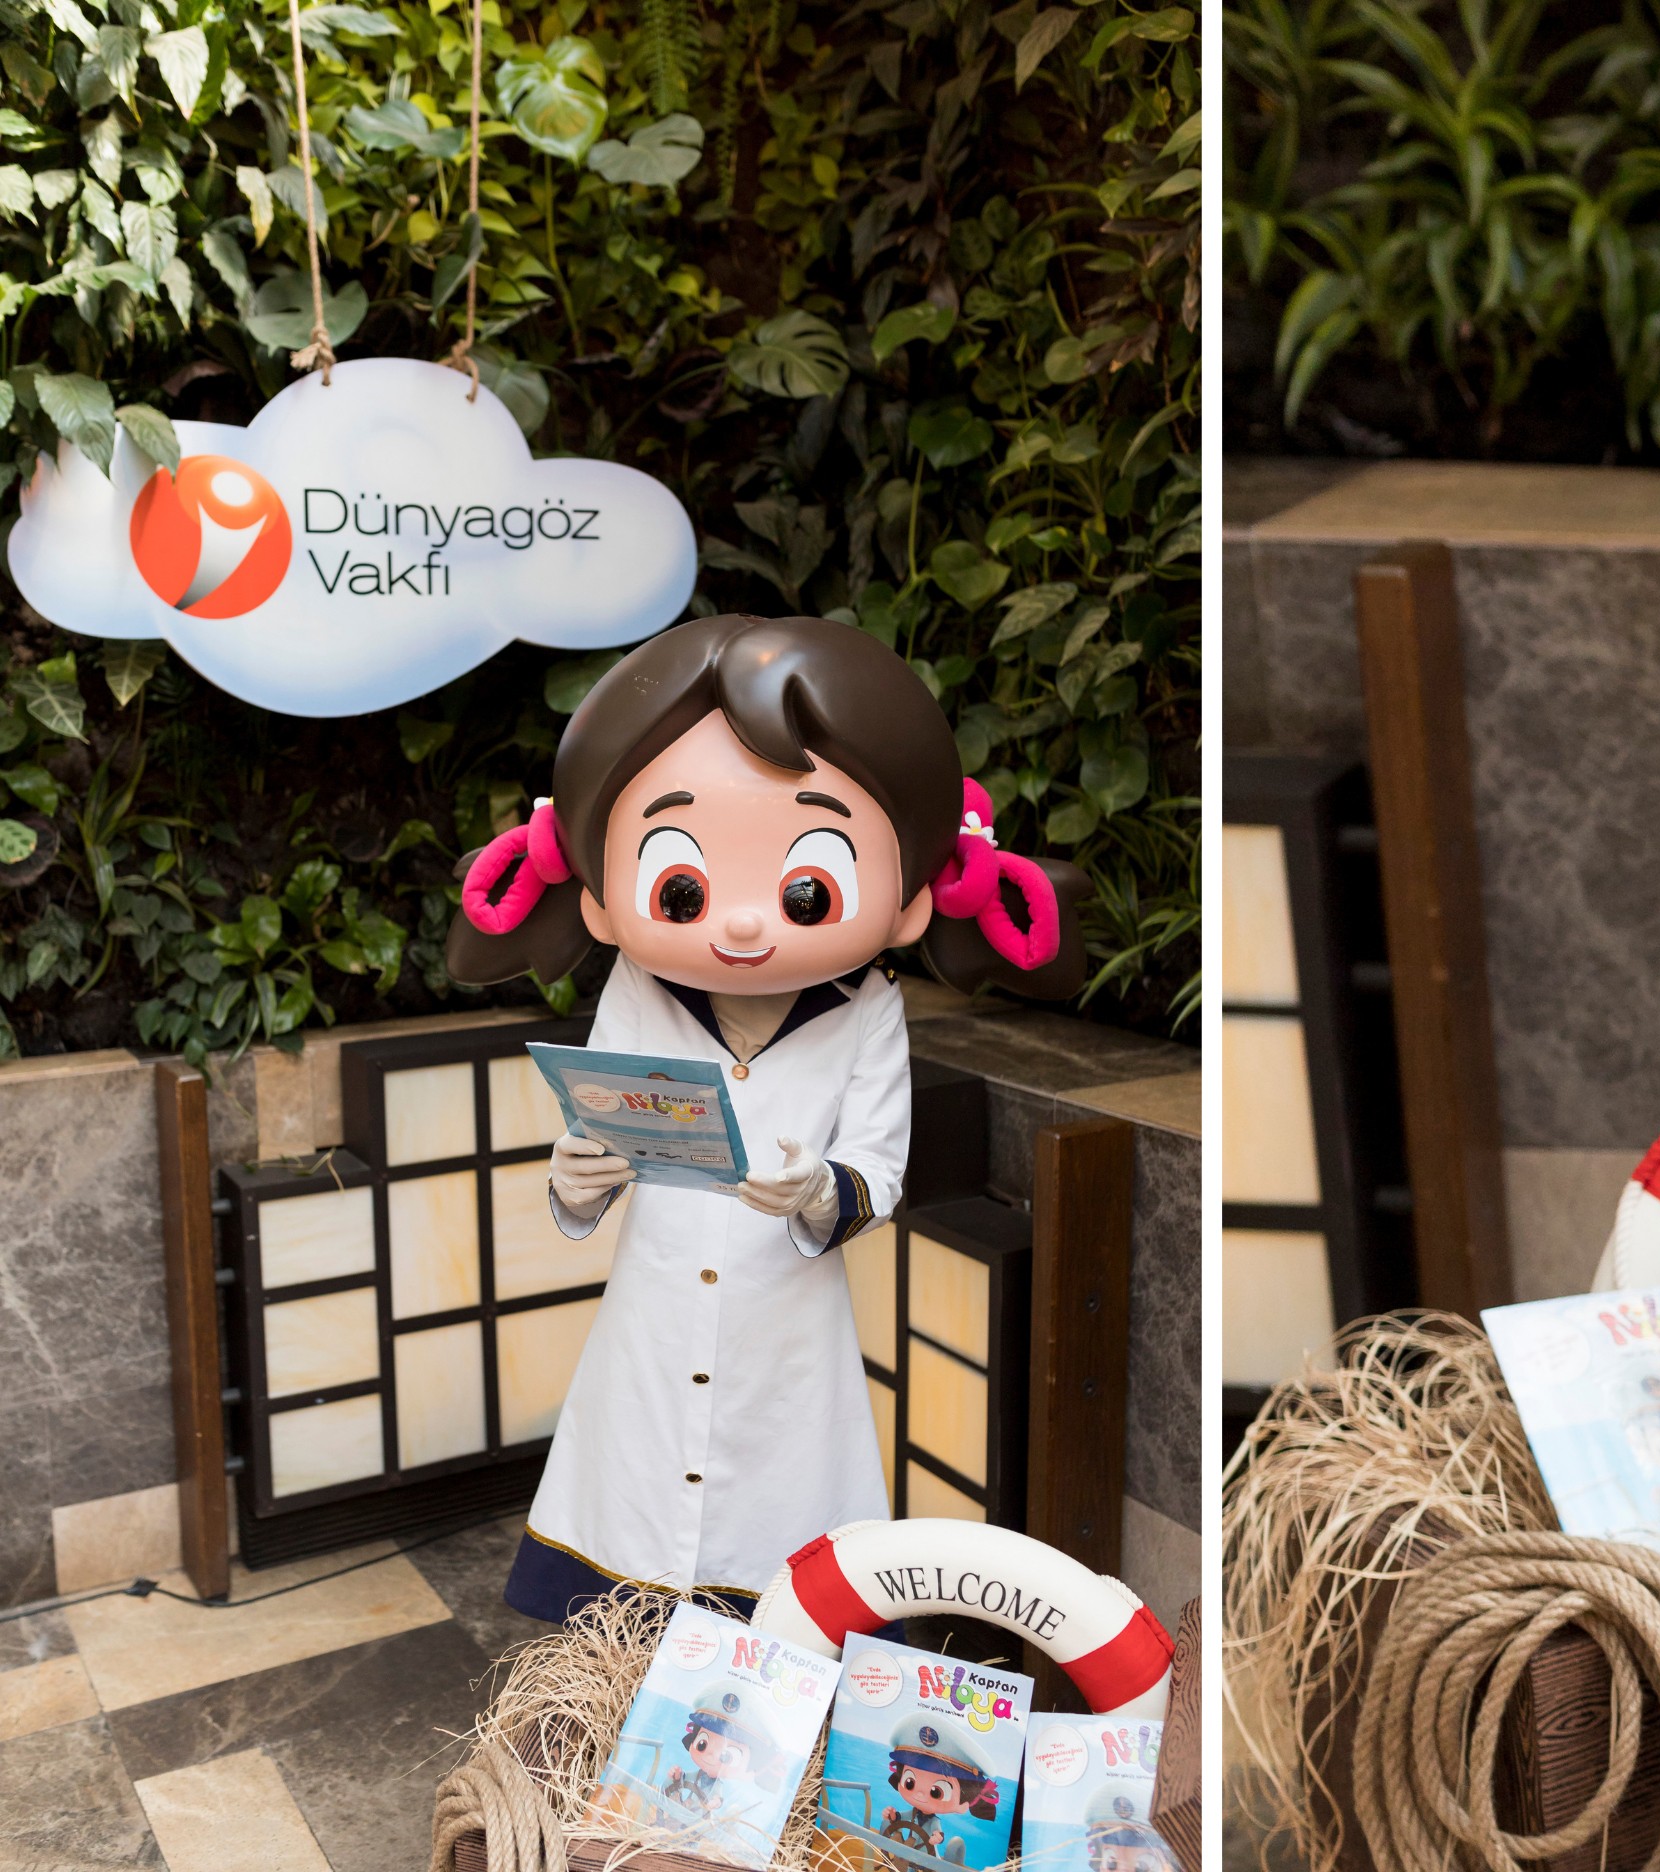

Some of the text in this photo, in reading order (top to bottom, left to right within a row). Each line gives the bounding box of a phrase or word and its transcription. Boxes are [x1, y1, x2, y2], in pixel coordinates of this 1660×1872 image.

[303, 487, 600, 549] Dünyagöz
[308, 549, 451, 595] Vakfı
[663, 1095, 706, 1104] Kaptan
[874, 1566, 1067, 1641] WELCOME
[781, 1649, 827, 1676] Kaptan
[968, 1672, 1018, 1695] Kaptan
[917, 1665, 1013, 1733] Niloya
